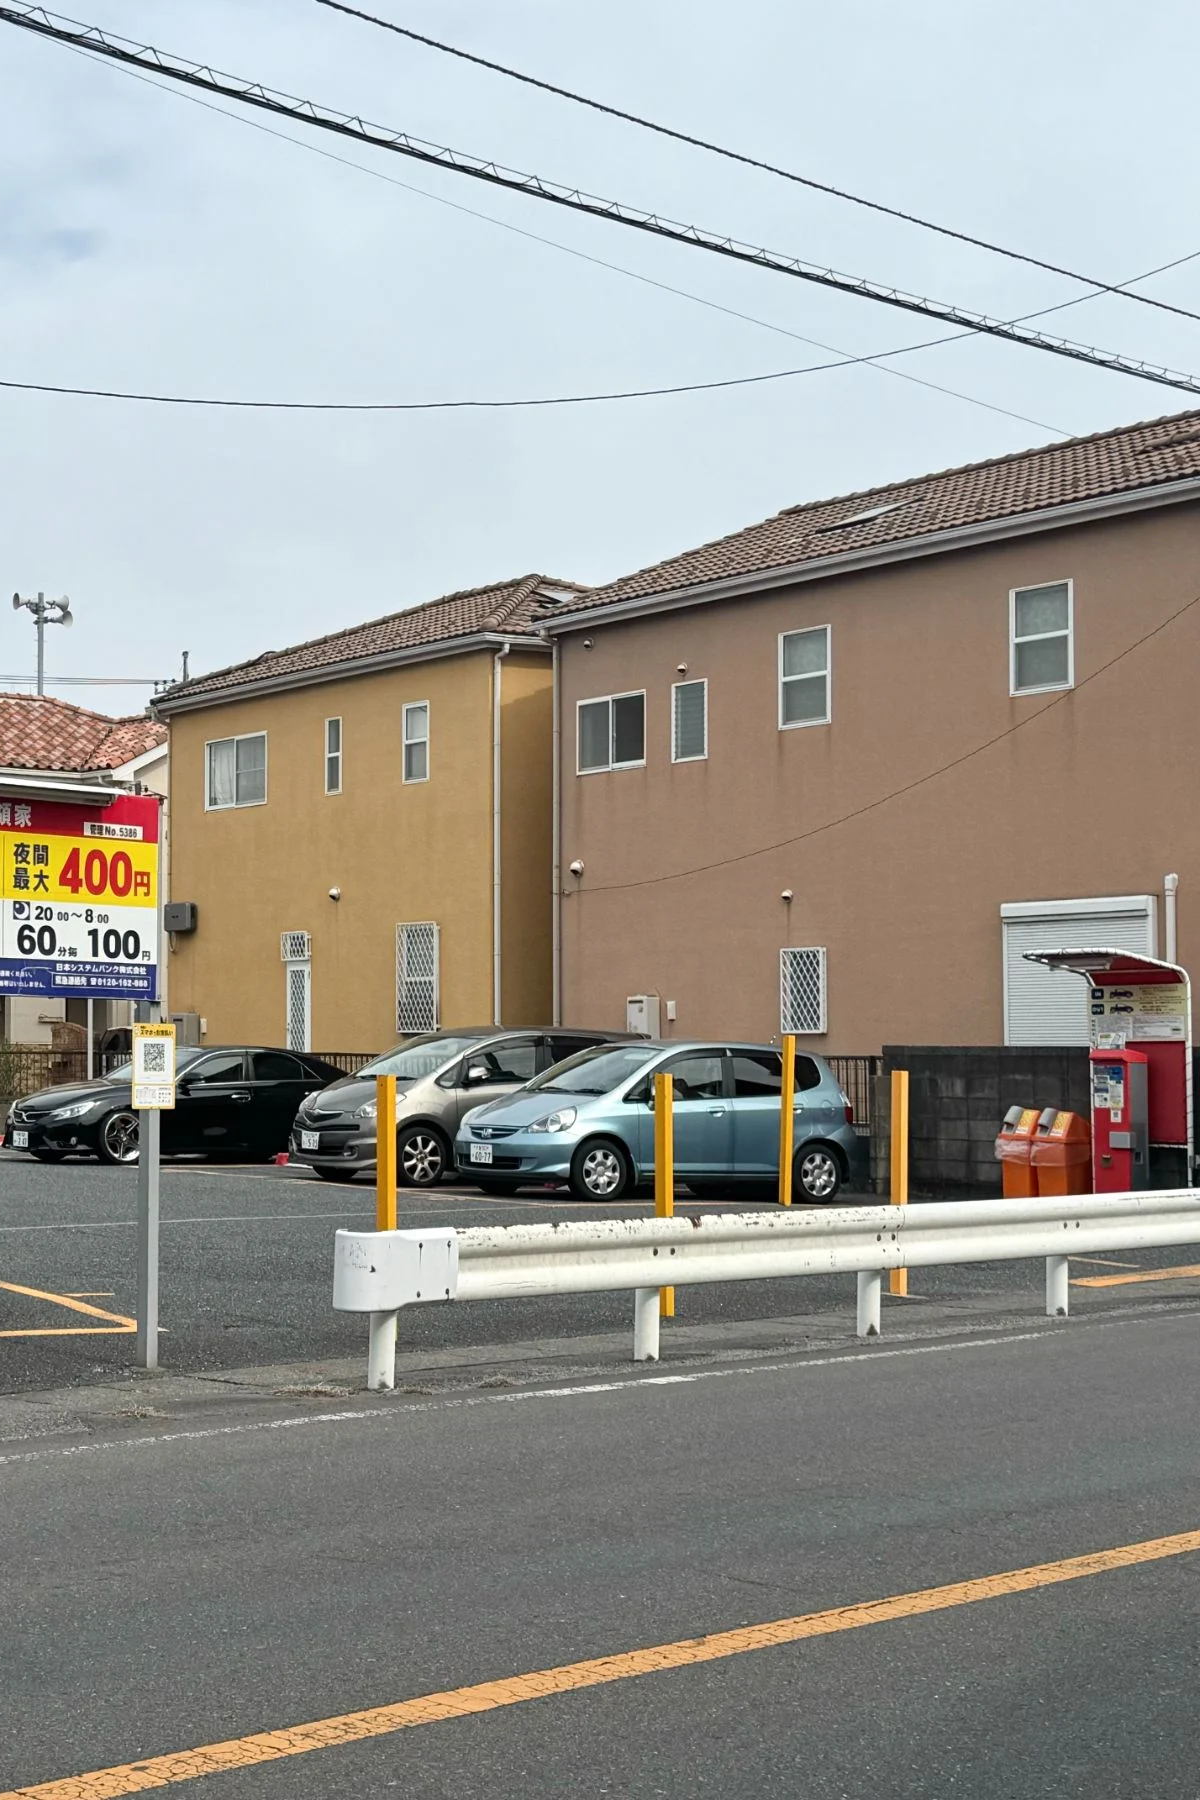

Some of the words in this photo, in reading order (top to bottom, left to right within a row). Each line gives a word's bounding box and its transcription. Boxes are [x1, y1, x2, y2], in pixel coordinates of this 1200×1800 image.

[13, 843, 49, 867] 夜間
[12, 871, 50, 893] 最大
[58, 847, 151, 897] 400円
[87, 928, 151, 962] 100円
[56, 963, 147, 975] 日本システムバンク株式会社
